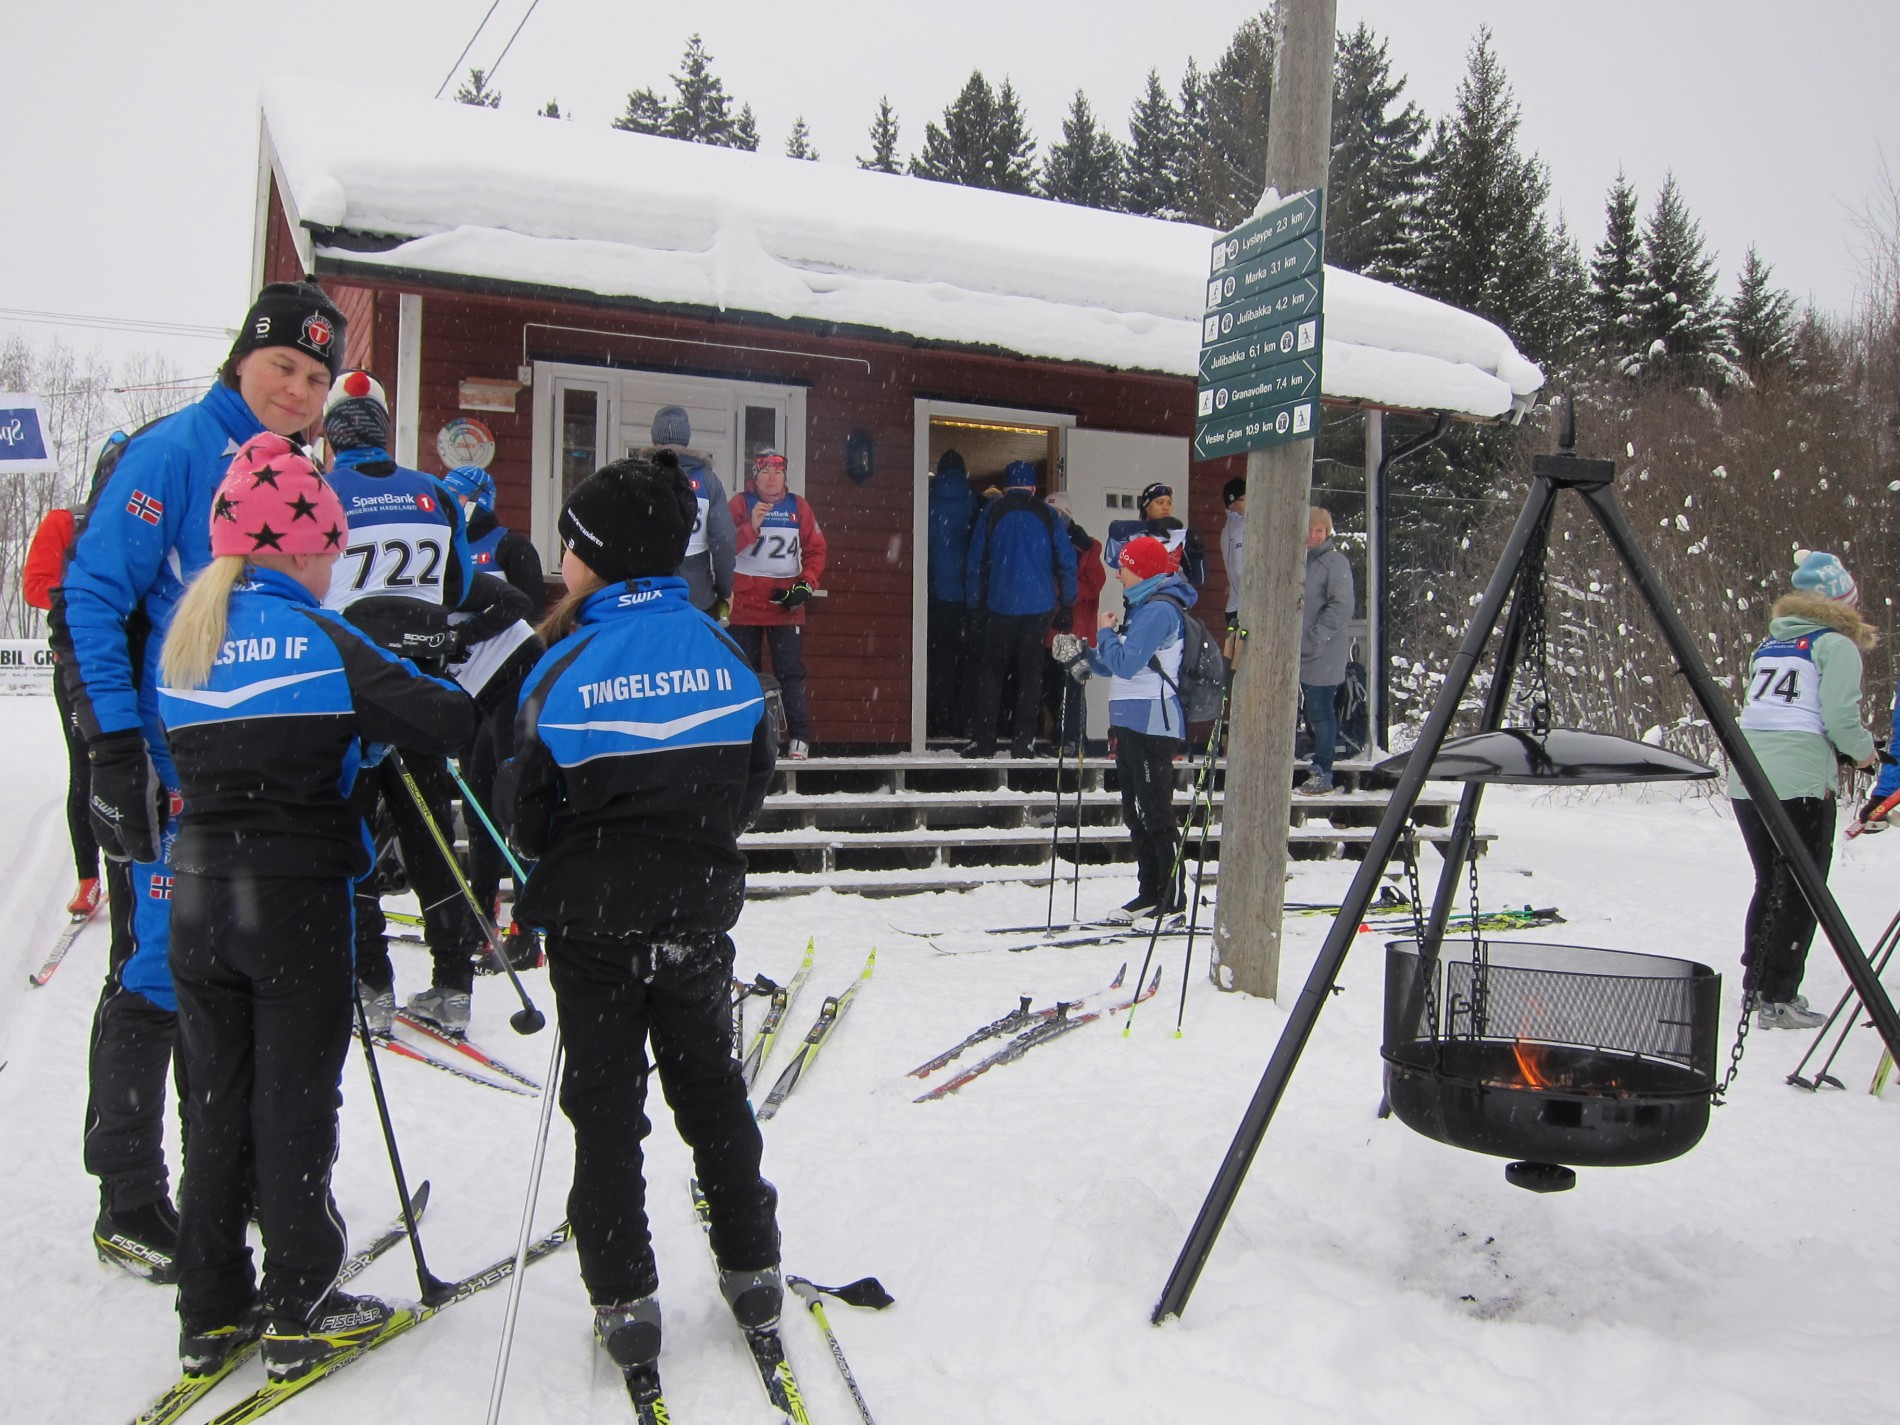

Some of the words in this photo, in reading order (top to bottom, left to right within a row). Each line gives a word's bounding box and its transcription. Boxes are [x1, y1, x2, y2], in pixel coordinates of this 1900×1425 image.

[1243, 227, 1273, 250] Lysløype
[1277, 217, 1288, 232] 2,3
[1291, 212, 1303, 225] km
[1245, 269, 1267, 285] Marka
[1271, 260, 1281, 275] 3,1
[1285, 256, 1296, 268] km
[1237, 305, 1272, 325] Julibakka
[1276, 297, 1288, 310] 4,2
[1292, 293, 1305, 306] km
[1211, 351, 1246, 370] Julibakka
[1249, 344, 1260, 358] 6,1
[1264, 342, 1276, 353] km
[1231, 383, 1272, 401] Granavollen
[1276, 377, 1287, 390] 7,4
[1291, 375, 1303, 386] km
[1205, 432, 1224, 445] Vestre
[1227, 429, 1242, 440] Gran
[1245, 423, 1260, 435] 10,9
[1262, 422, 1273, 432] km
[352, 493, 415, 507] SpareBank
[749, 535, 798, 559] 724
[344, 539, 442, 591] 722
[617, 589, 662, 607] SWIX
[0, 650, 26, 665] BIL
[285, 636, 309, 659] IF
[578, 668, 710, 709] TINGELSTAD
[1752, 666, 1800, 704] 74
[109, 1233, 173, 1268] FISCHER
[414, 1264, 515, 1322] FCHER
[319, 1307, 382, 1331] FISCHER
